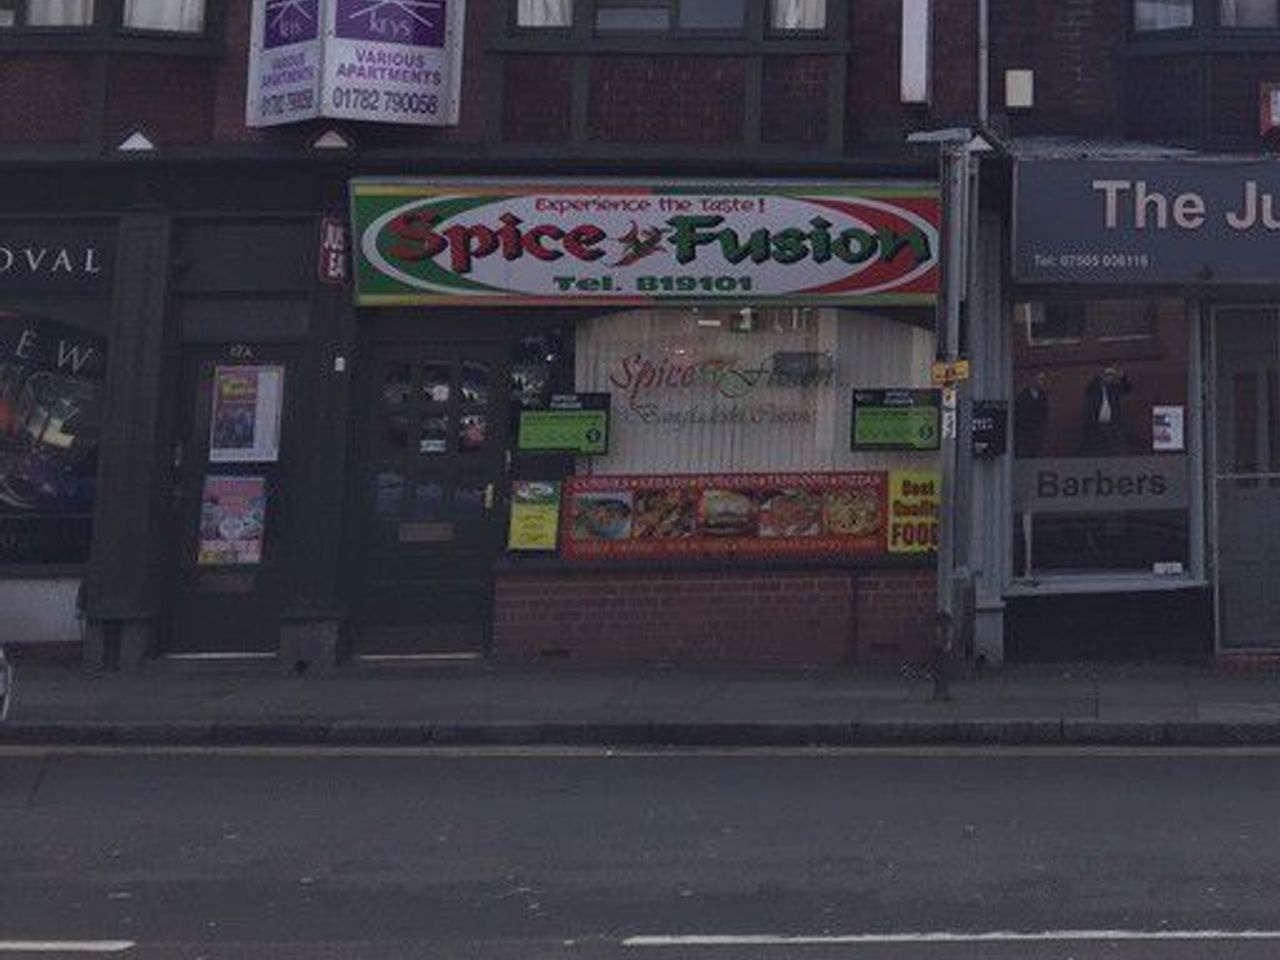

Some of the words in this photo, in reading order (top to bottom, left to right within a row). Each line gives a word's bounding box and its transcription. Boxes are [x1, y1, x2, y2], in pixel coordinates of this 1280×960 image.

[355, 49, 426, 68] VARIOUS
[336, 64, 441, 86] APARTMENTS
[332, 87, 379, 111] 01782
[535, 196, 651, 215] Experience
[659, 196, 696, 212] the
[1092, 179, 1206, 230] The
[387, 210, 608, 274] Spice
[665, 215, 933, 266] Fusion
[553, 275, 622, 292] Tel.
[636, 275, 753, 292] 819101
[902, 480, 936, 496] Best
[1036, 470, 1168, 498] Barbers
